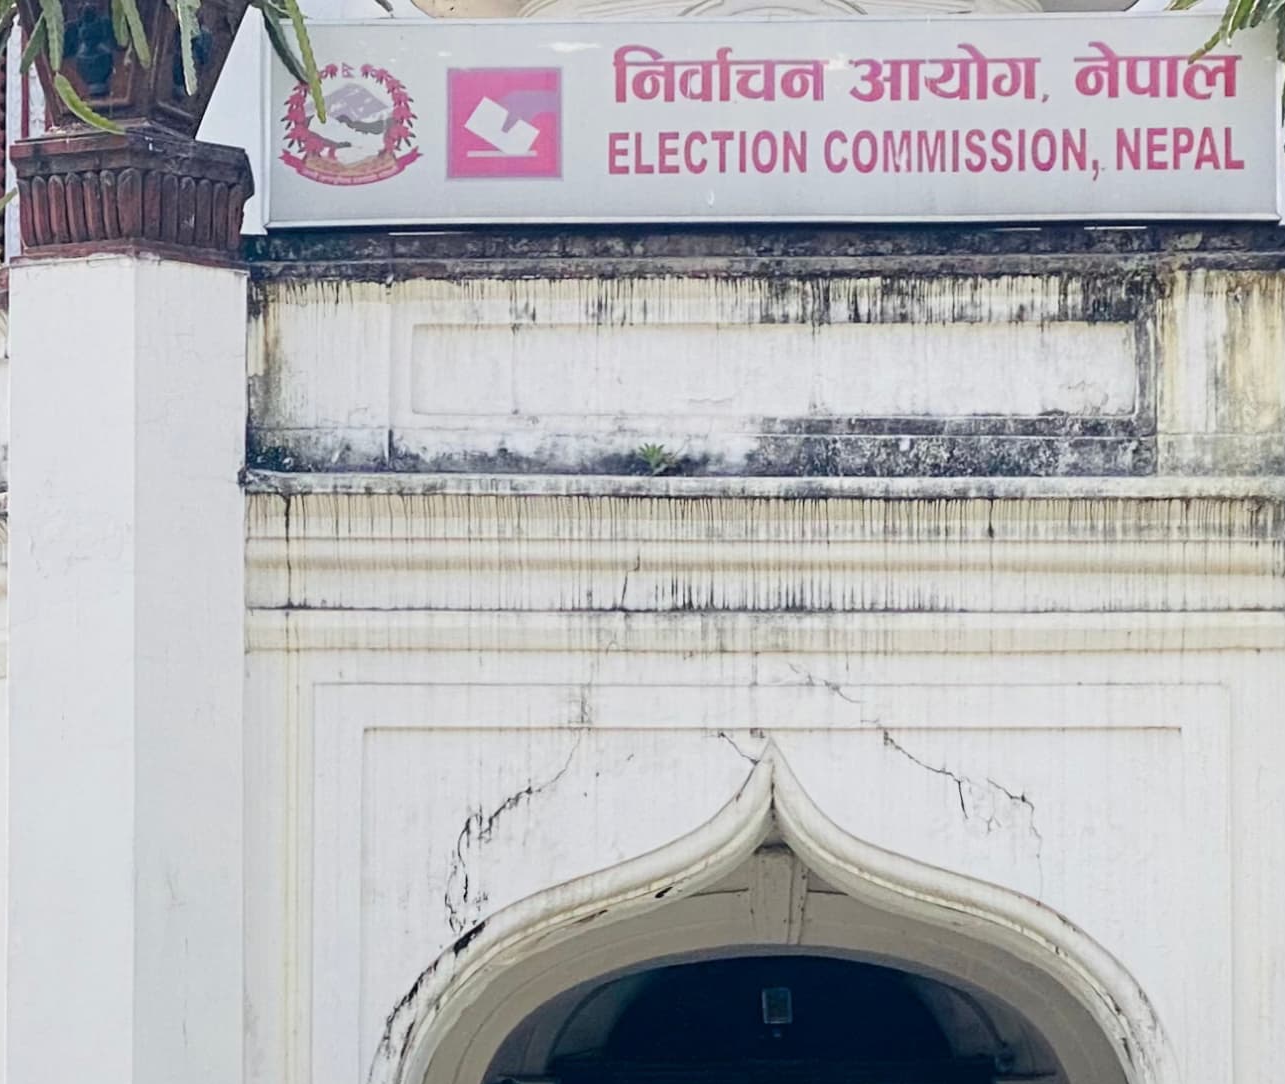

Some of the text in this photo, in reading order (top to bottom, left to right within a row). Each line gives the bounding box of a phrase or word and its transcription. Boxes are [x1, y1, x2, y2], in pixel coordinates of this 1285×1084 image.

[613, 41, 1242, 103] निर्वाचन आयोग, नेपाल
[608, 127, 1245, 181] ELECTION COMMISSION, NEPAL
